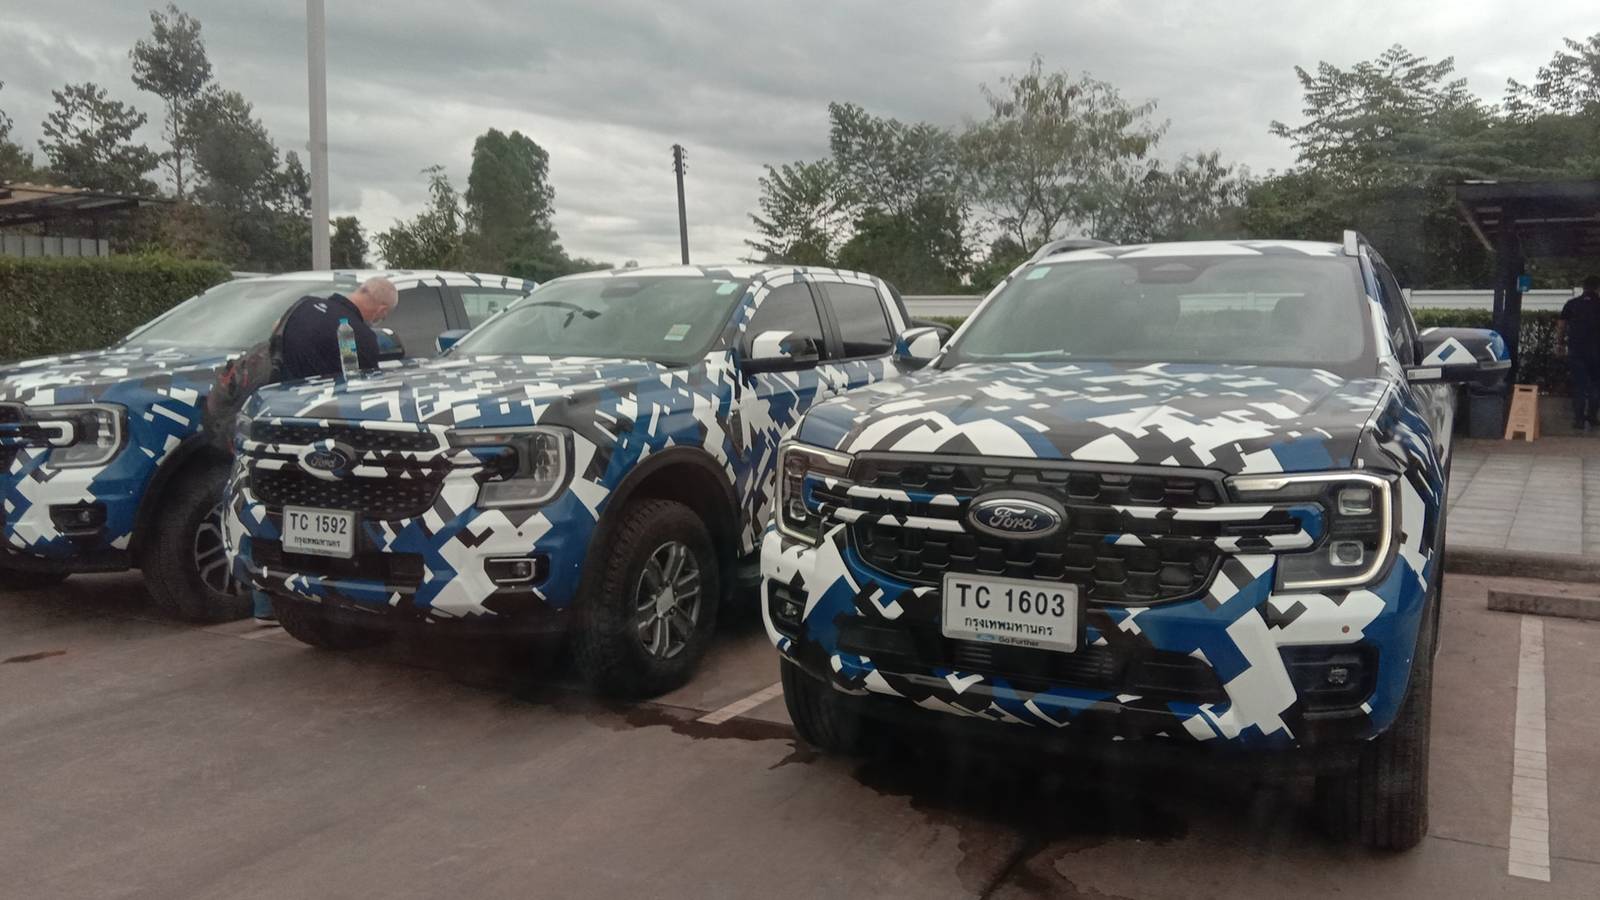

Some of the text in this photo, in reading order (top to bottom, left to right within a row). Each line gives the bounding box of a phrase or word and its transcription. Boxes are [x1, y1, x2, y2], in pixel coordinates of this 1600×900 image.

[290, 513, 347, 535] TC 1592
[989, 506, 1039, 530] Ford
[956, 583, 1065, 617] TC 1603
[965, 616, 1054, 636] กรุงเทพมหานคร
